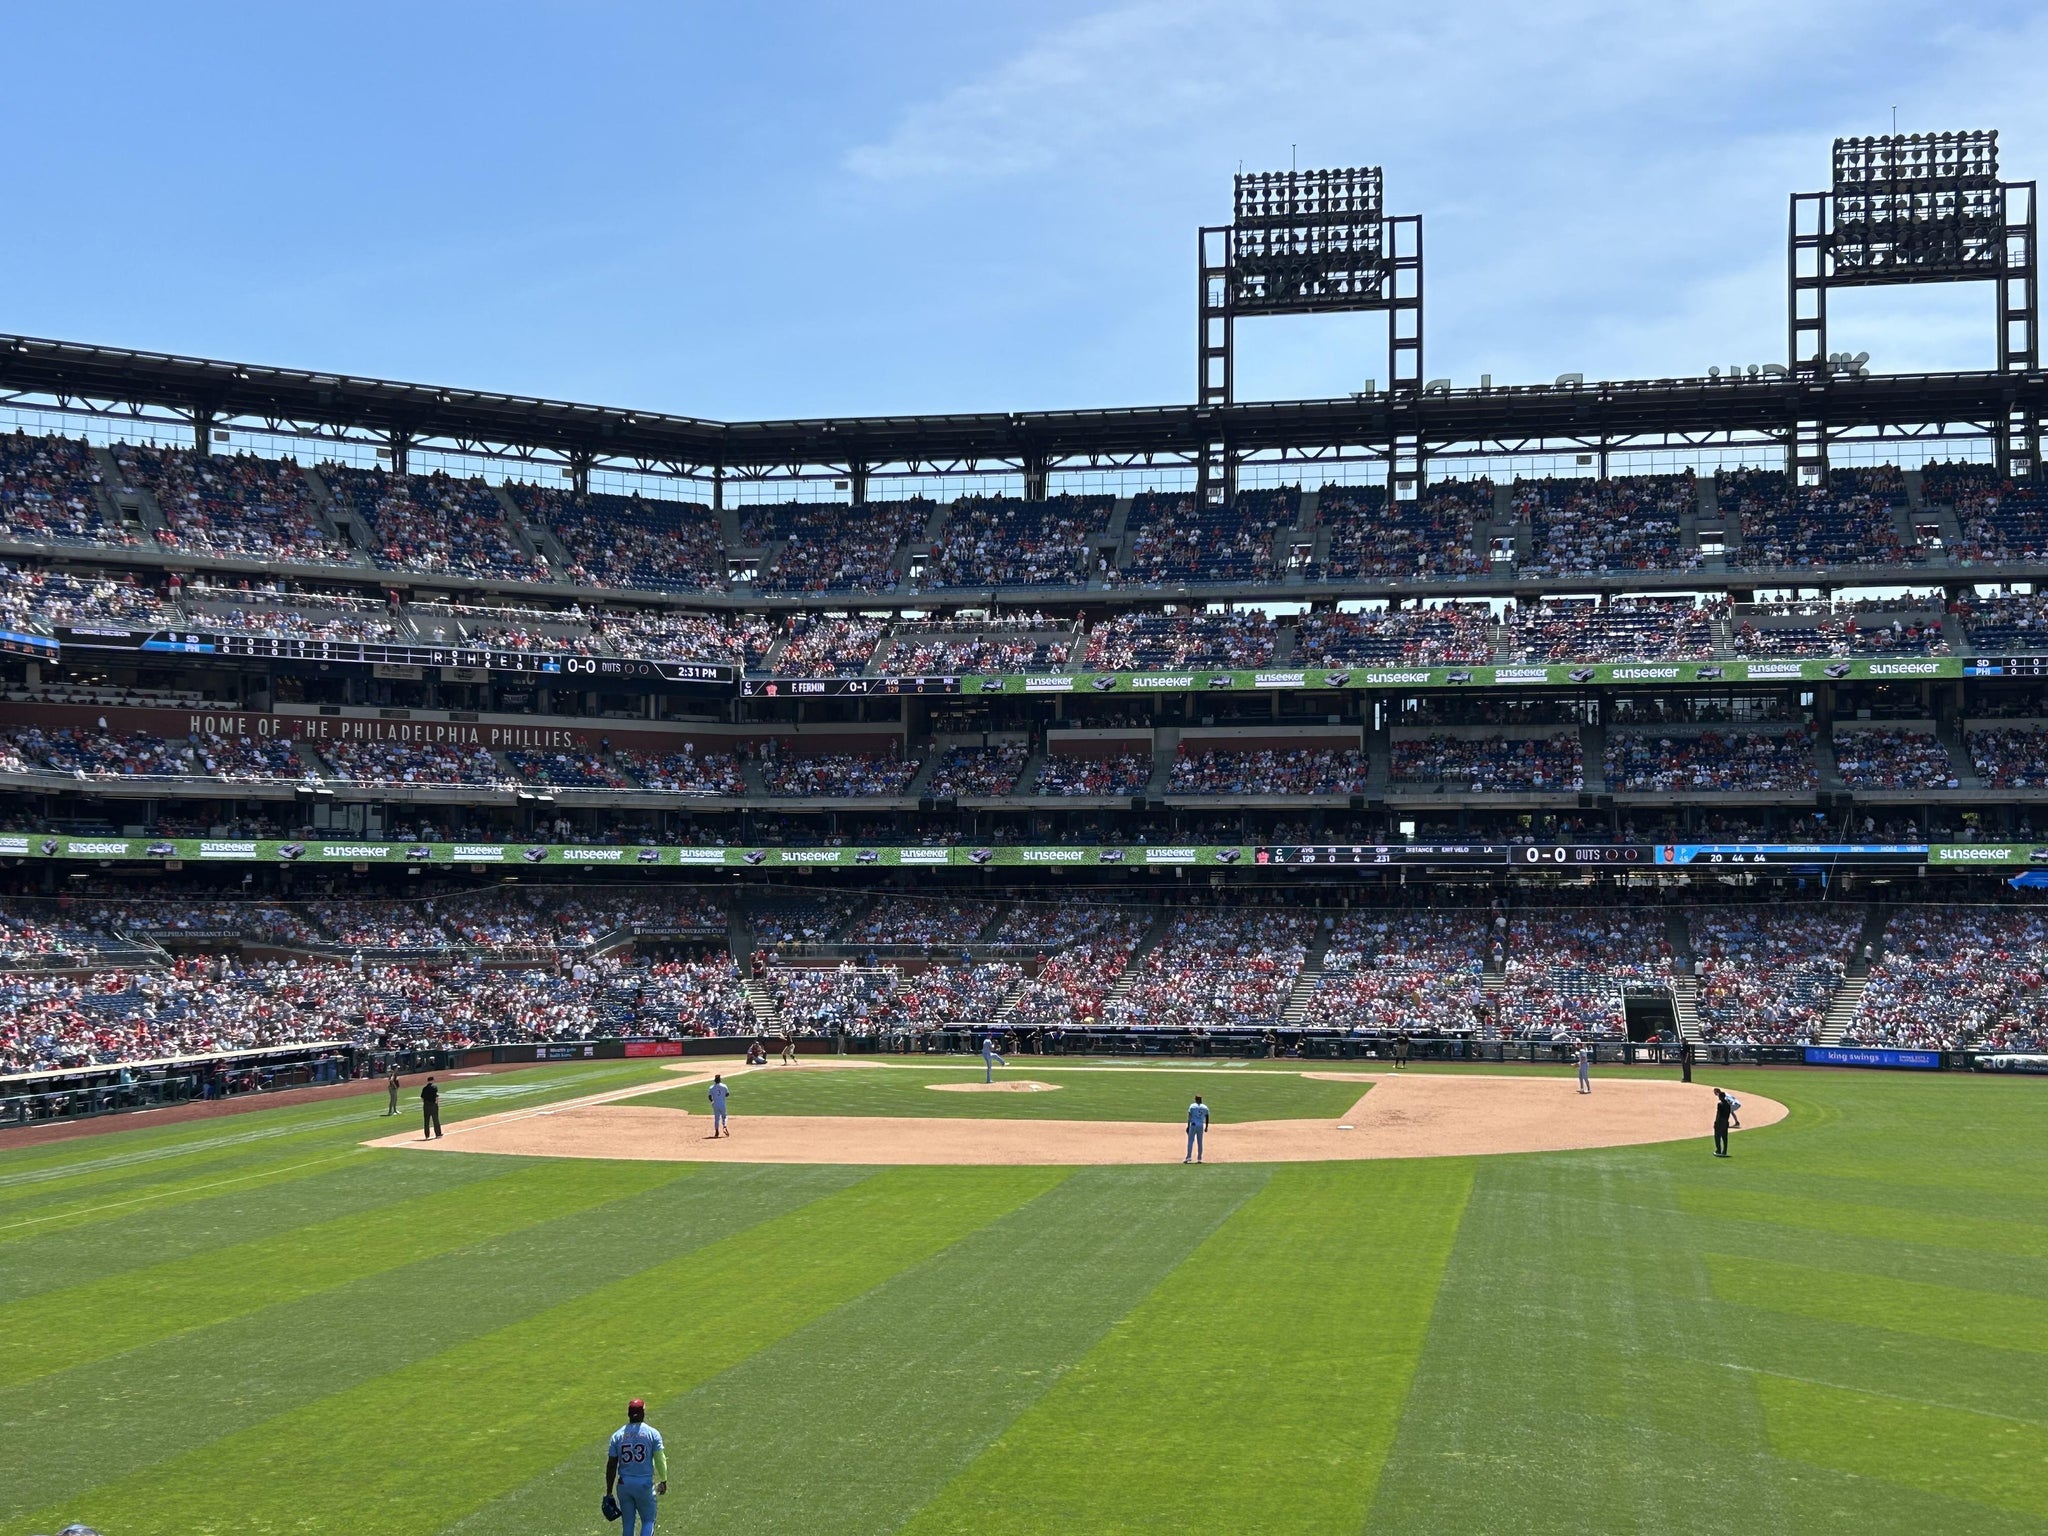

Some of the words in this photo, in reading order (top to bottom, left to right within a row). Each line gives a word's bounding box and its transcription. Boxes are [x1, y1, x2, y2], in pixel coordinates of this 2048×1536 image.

[186, 635, 199, 643] SD
[434, 652, 442, 663] R
[468, 654, 476, 664] H
[501, 656, 507, 666] E
[568, 659, 596, 674] 0-0
[602, 662, 620, 672] OUTS
[1748, 664, 1801, 672] sunseeker
[1870, 663, 1940, 673] sunseeker
[679, 667, 699, 677] 2:31
[703, 668, 716, 678] PM
[1367, 673, 1430, 682] sunseeker
[1496, 669, 1547, 677] sunseeker
[1612, 668, 1679, 678] sunseeker
[1026, 677, 1073, 685] sunseeker
[1132, 677, 1193, 686] sunseeker
[792, 683, 798, 692] F.
[799, 683, 824, 692] FERMIN
[850, 682, 867, 692] 0-1
[191, 716, 245, 734] HOME
[258, 719, 280, 735] OF
[342, 722, 478, 743] PHILADELPHIA
[492, 728, 571, 747] PHILLIES
[68, 843, 128, 853] sunseeker
[201, 843, 256, 852] sunseeker
[323, 846, 390, 857] sunseeker
[564, 850, 623, 859] sunseeker
[782, 850, 841, 861] sunseeker
[900, 850, 948, 858] sunseeker
[1024, 851, 1084, 860] sunseeker
[1576, 850, 1600, 860] OUTS
[1940, 849, 2011, 859] sunseeker
[1828, 1052, 1848, 1061] king
[1849, 1053, 1879, 1062] swings
[621, 1444, 646, 1463] 53
